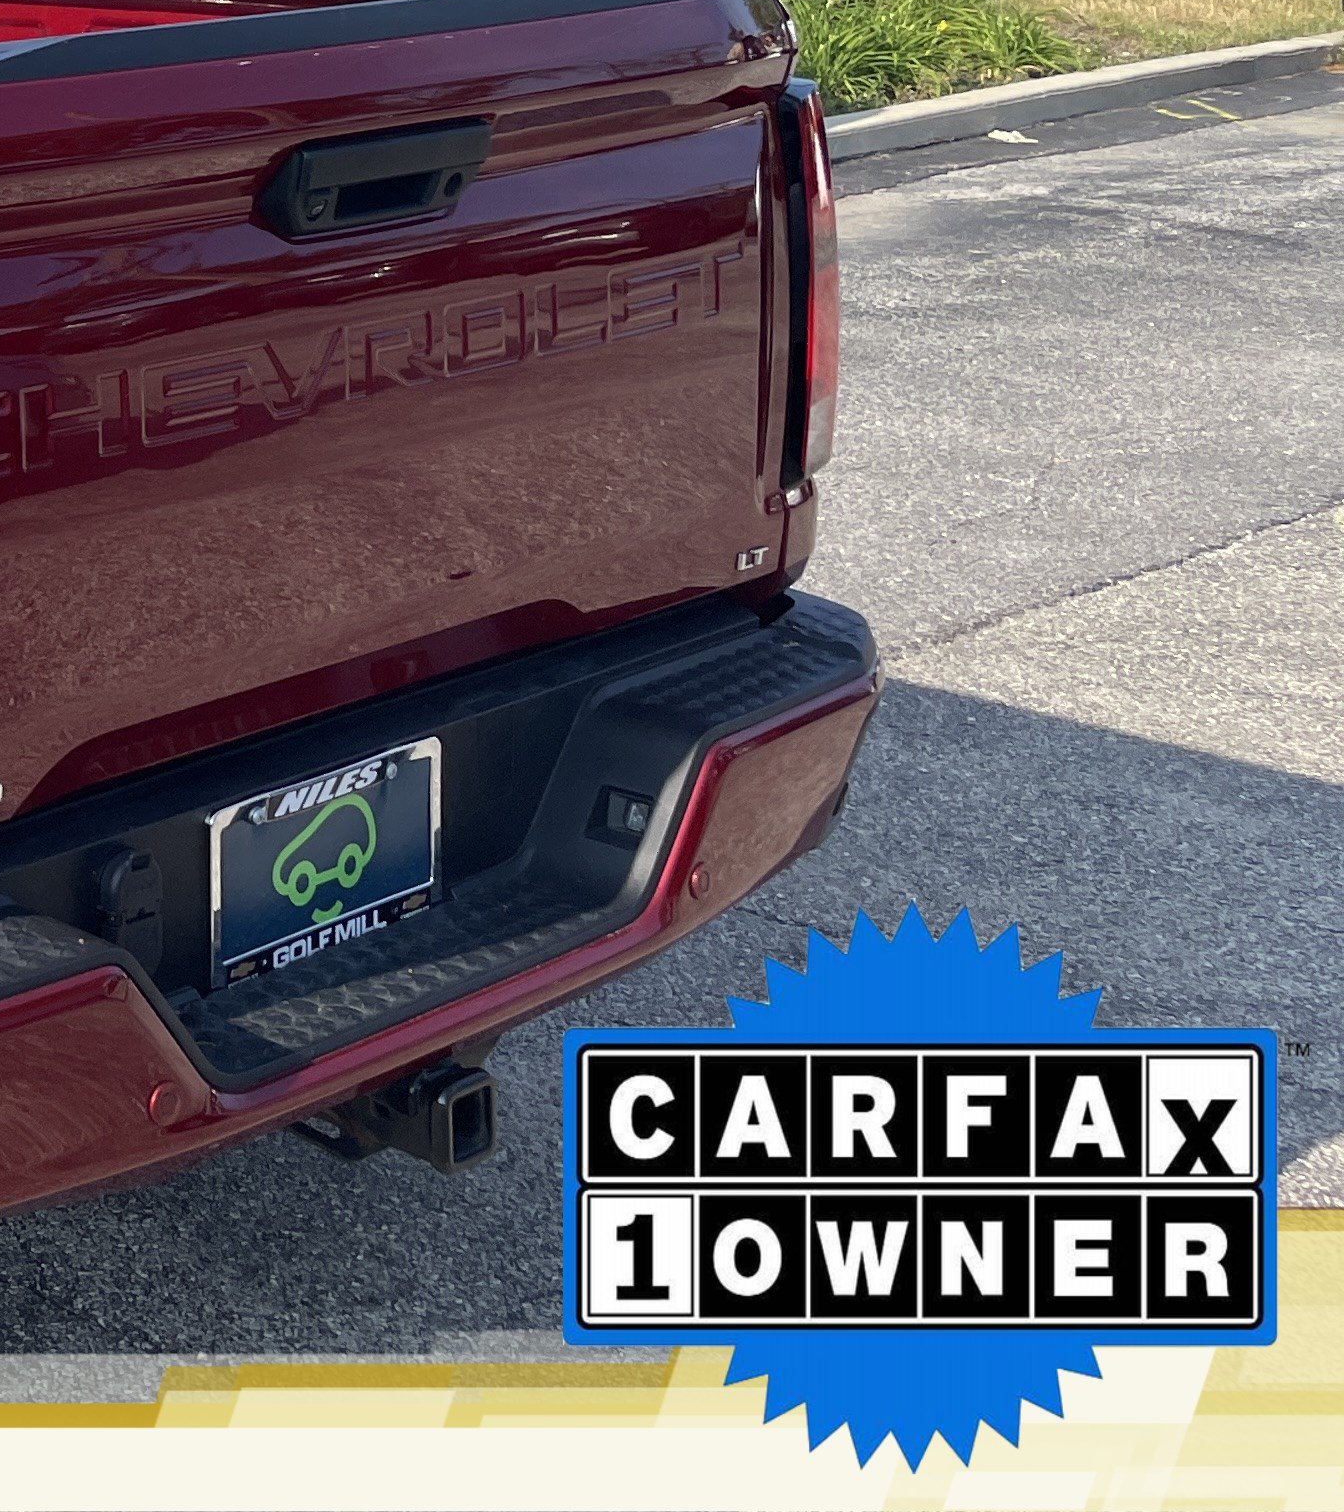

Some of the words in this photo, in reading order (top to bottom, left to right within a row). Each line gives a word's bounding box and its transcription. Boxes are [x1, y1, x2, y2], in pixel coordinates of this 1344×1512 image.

[737, 546, 770, 571] LT
[273, 760, 383, 818] NILES
[272, 929, 332, 970] GOLF
[334, 909, 387, 945] MILL
